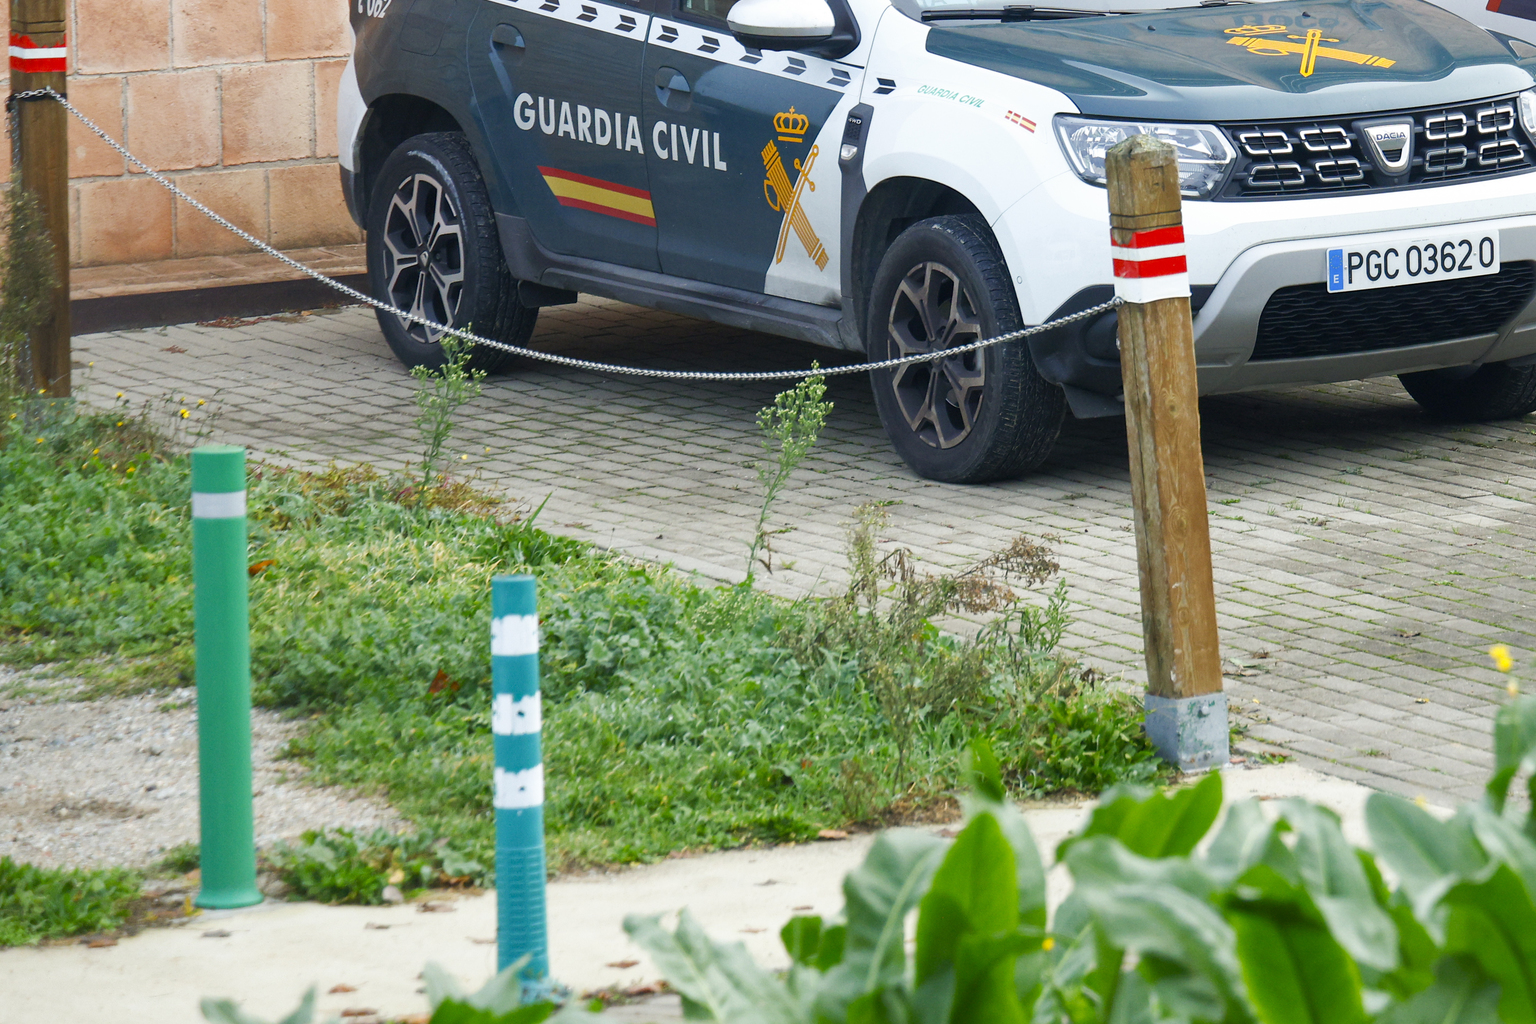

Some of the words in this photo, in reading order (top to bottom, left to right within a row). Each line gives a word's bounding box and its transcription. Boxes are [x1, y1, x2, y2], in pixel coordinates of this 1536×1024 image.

[916, 84, 959, 101] GUARDIA
[958, 94, 986, 108] CIVIL
[513, 91, 645, 155] GUARDIA
[652, 119, 728, 172] CIVIL
[1375, 131, 1406, 141] DACIA
[1347, 247, 1400, 285] PGC
[1333, 274, 1340, 284] E
